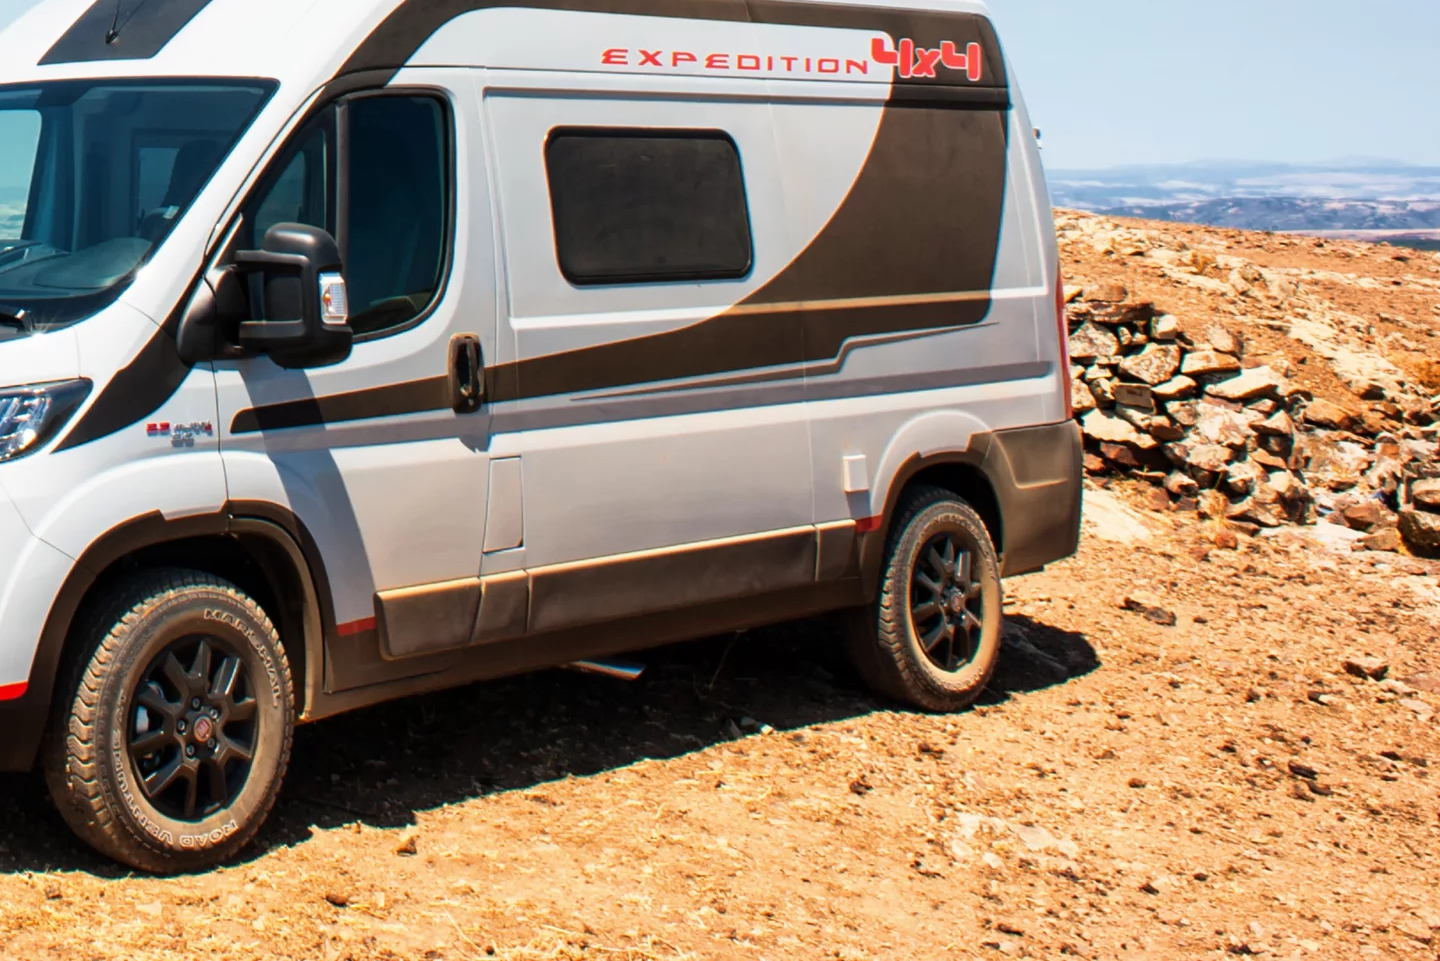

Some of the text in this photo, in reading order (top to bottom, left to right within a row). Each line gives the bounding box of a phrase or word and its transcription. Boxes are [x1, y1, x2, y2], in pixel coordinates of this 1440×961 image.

[600, 37, 981, 81] EXPEDITION 4x4
[203, 607, 281, 708] MARSHAL
[113, 729, 173, 846] VENTURE
[179, 819, 239, 849] ROAD
